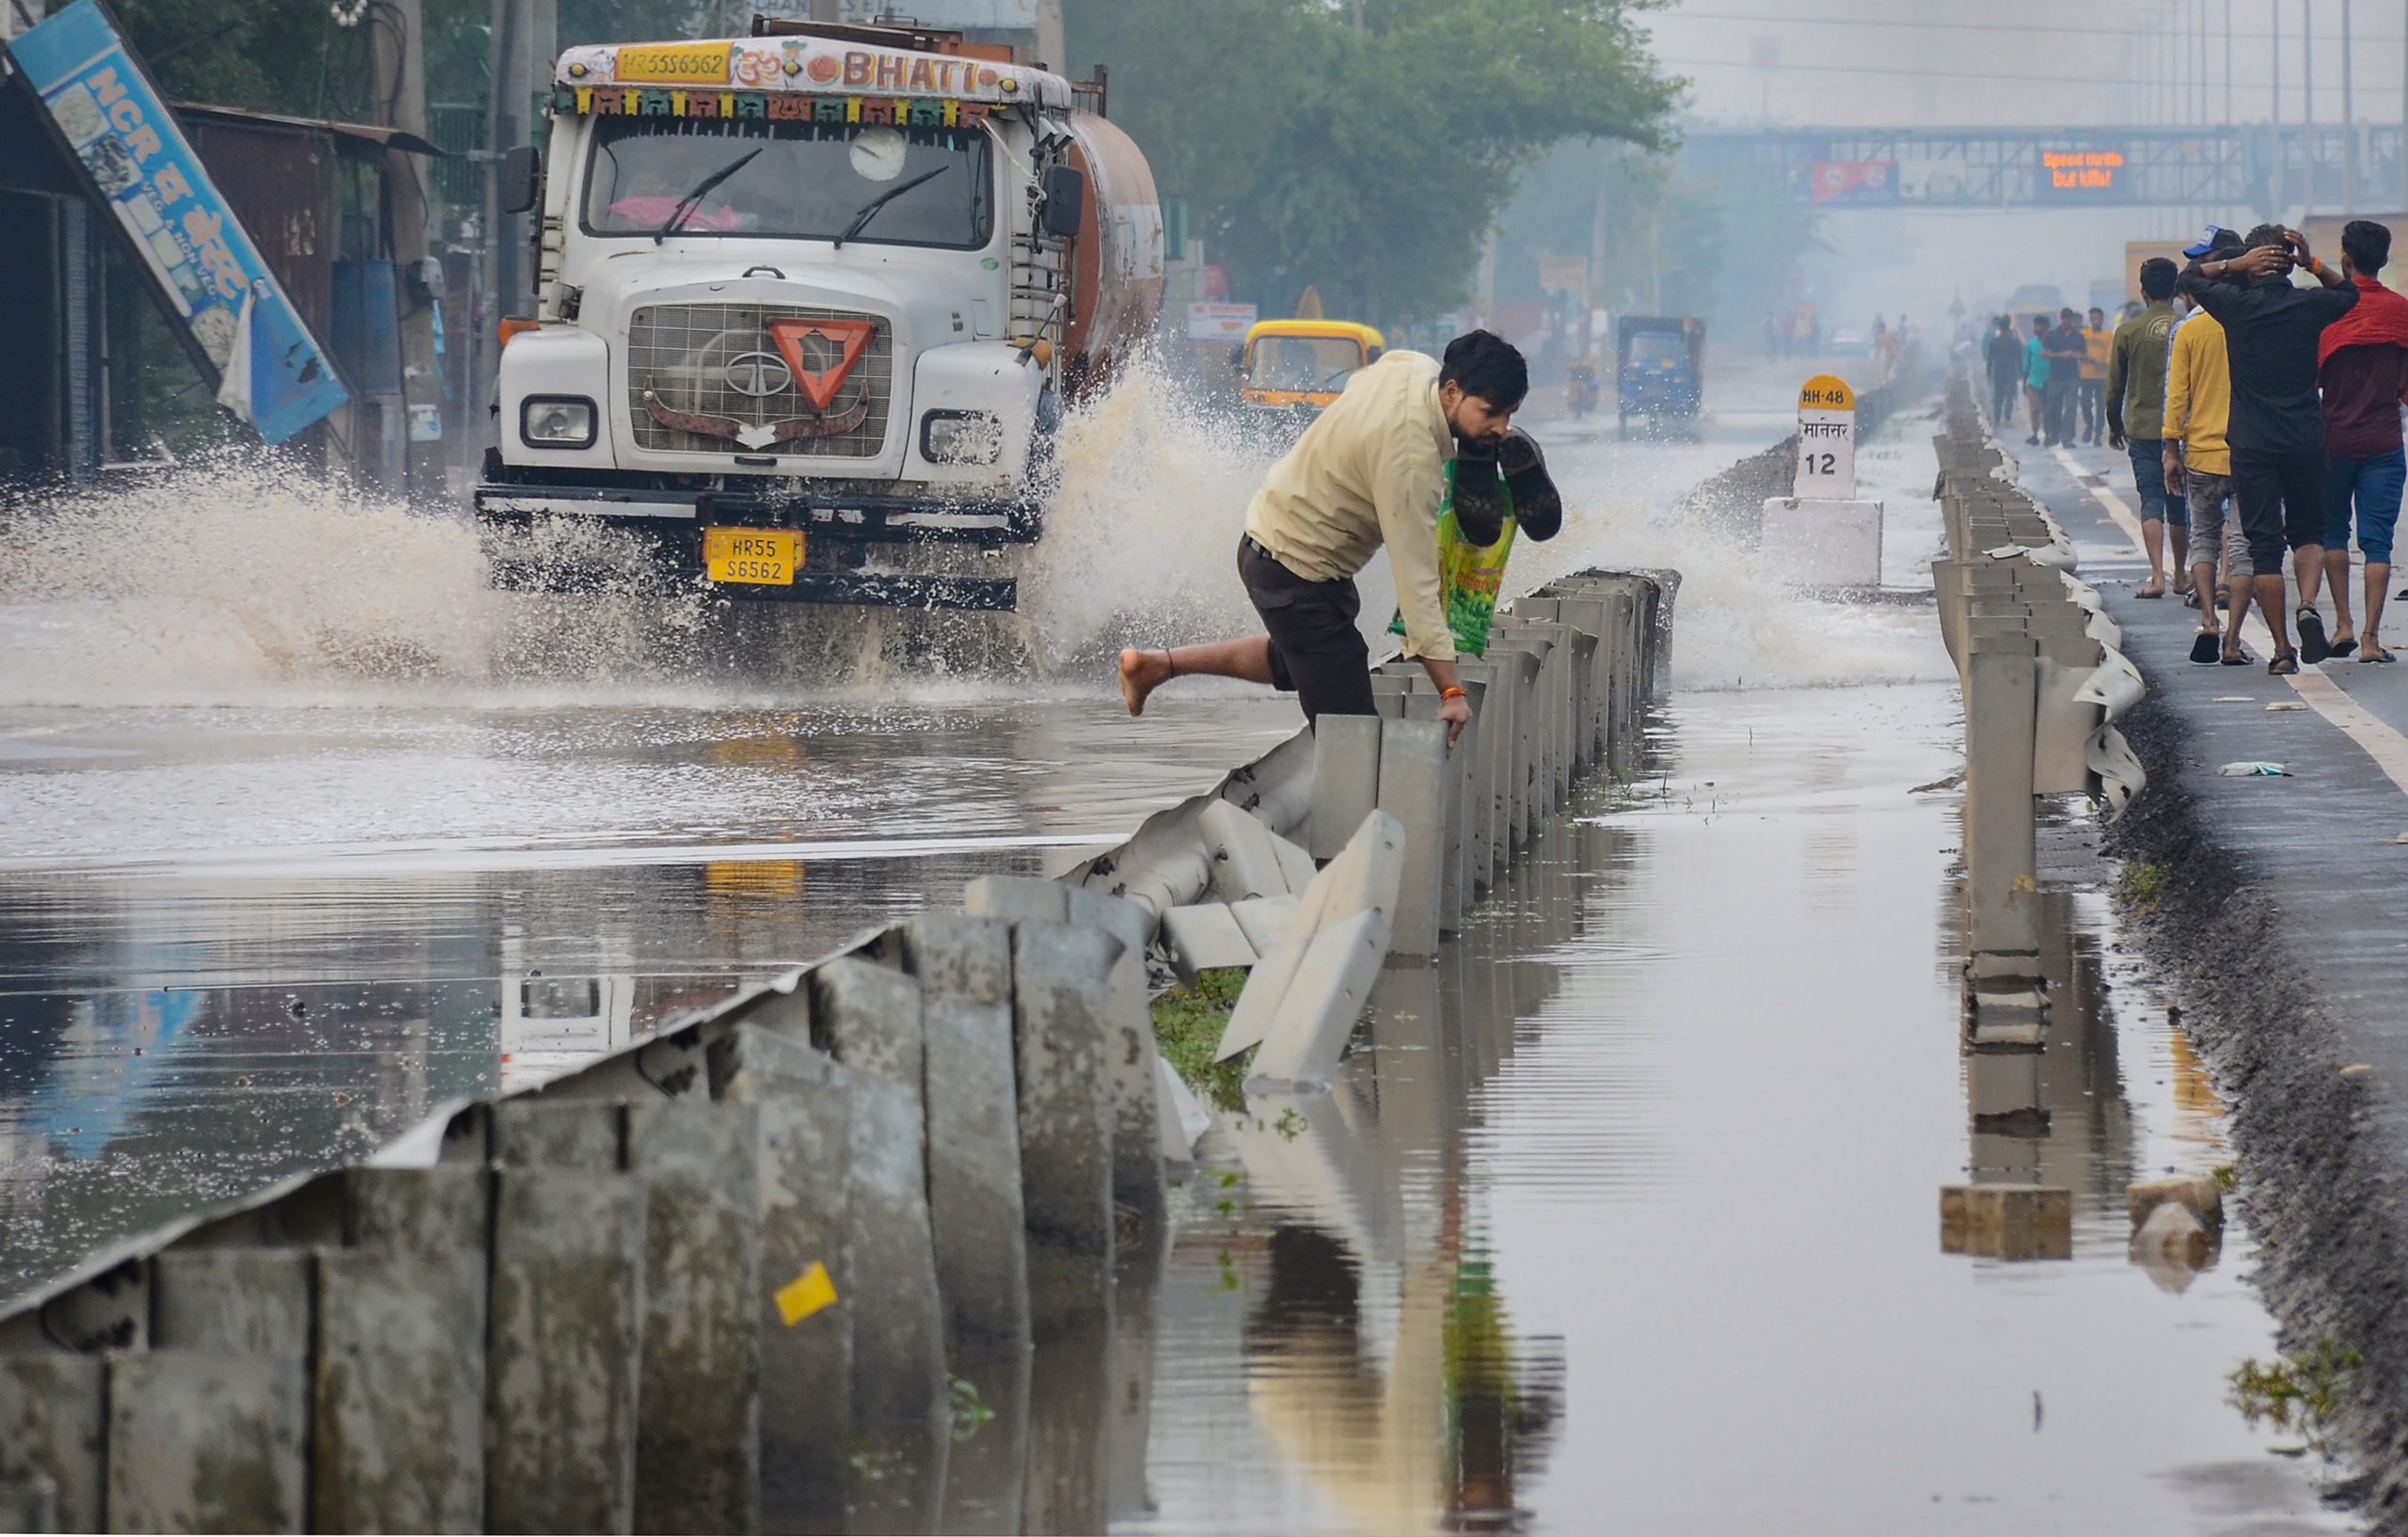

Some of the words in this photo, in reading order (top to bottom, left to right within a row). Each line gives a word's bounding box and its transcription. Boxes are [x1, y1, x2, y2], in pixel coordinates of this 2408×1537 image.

[843, 51, 977, 92] BHATI
[88, 66, 162, 165] NCR
[174, 231, 198, 263] NON
[1806, 452, 1836, 475] 12
[733, 539, 776, 557] HR55
[727, 560, 782, 579] S6562
